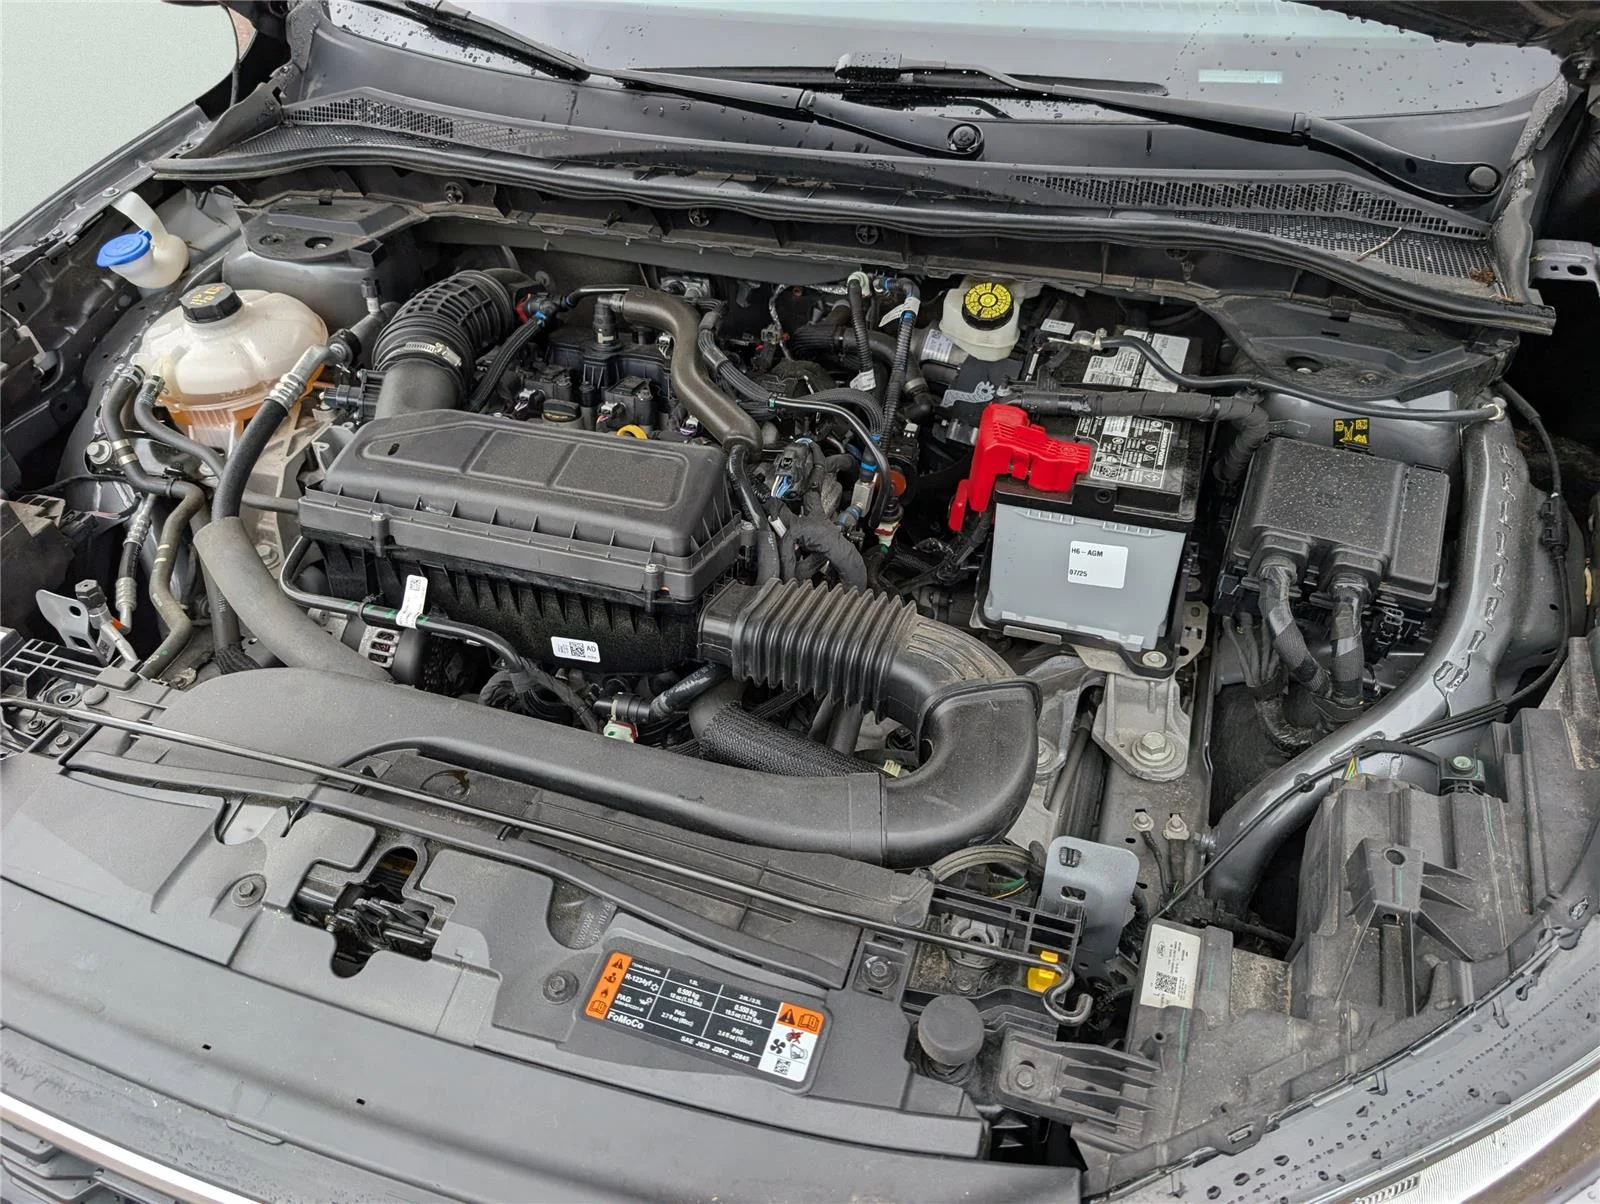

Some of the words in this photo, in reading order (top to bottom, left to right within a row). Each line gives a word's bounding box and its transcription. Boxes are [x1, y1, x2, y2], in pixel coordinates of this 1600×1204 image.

[1071, 547, 1080, 555] H6
[1087, 549, 1103, 558] AGM
[1069, 568, 1088, 577] 07/25
[625, 973, 652, 987] R-1234yf
[616, 993, 632, 1003] PAG
[673, 1008, 687, 1018] PAG
[607, 1011, 644, 1029] FoMoCo
[731, 1026, 745, 1036] PAG
[681, 1036, 694, 1044] SAE
